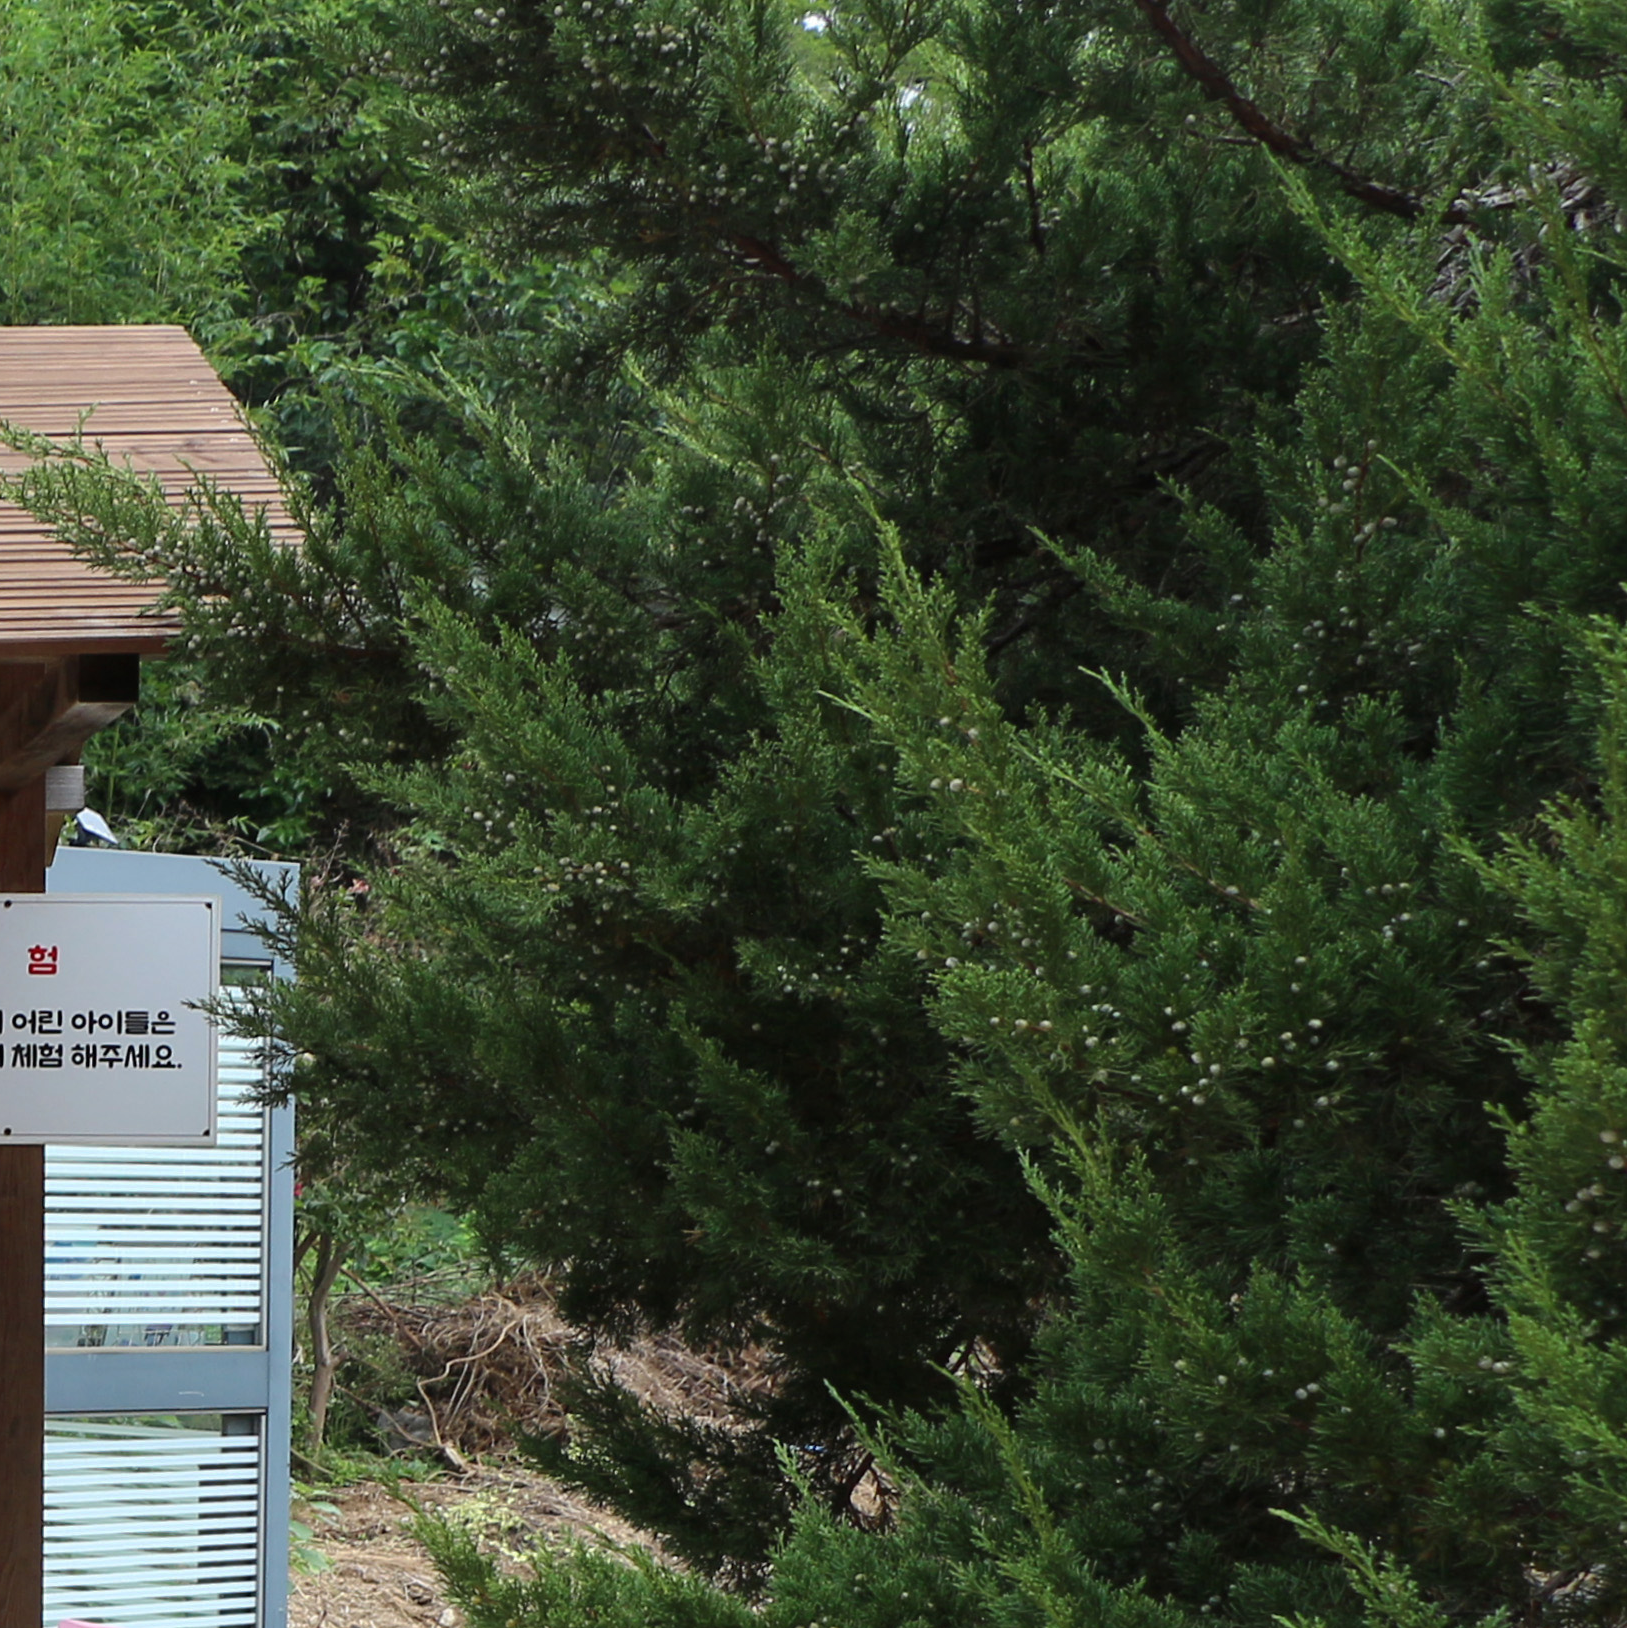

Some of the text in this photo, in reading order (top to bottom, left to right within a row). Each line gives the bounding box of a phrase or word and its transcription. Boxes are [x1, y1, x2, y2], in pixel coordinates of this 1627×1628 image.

[27, 944, 58, 975] 험
[12, 1009, 63, 1034] 어린
[71, 1010, 176, 1035] 아이들은
[12, 1042, 63, 1069] 체험
[71, 1043, 183, 1069] 해주세요.
